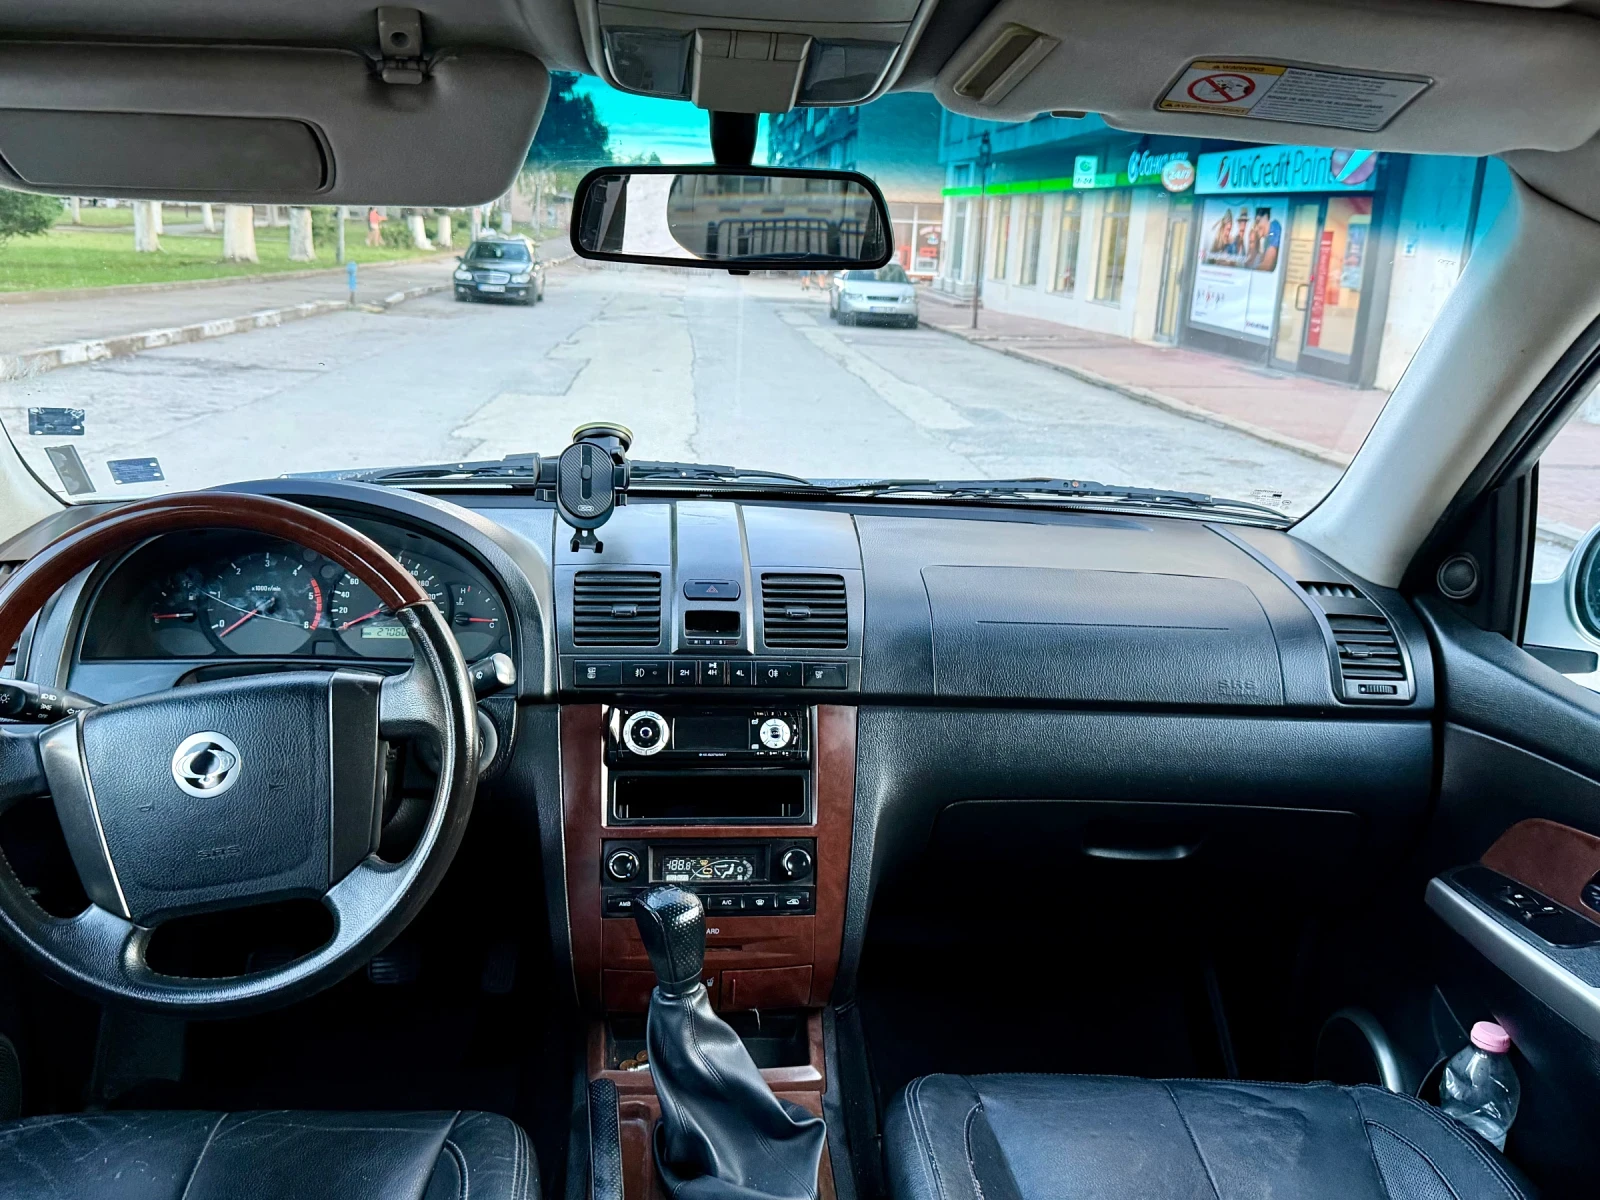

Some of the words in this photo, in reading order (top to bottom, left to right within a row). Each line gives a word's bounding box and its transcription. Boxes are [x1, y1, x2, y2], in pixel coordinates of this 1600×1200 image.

[1231, 152, 1290, 189] UniCredit
[1293, 149, 1333, 186] Point
[264, 559, 271, 568] 3
[235, 567, 242, 575] 2
[292, 568, 298, 576] 4
[308, 592, 314, 600] 5
[338, 606, 348, 614] 20
[219, 620, 225, 628] 0
[303, 620, 309, 629] 6
[735, 669, 745, 677] 4L
[705, 927, 720, 935] ARD
